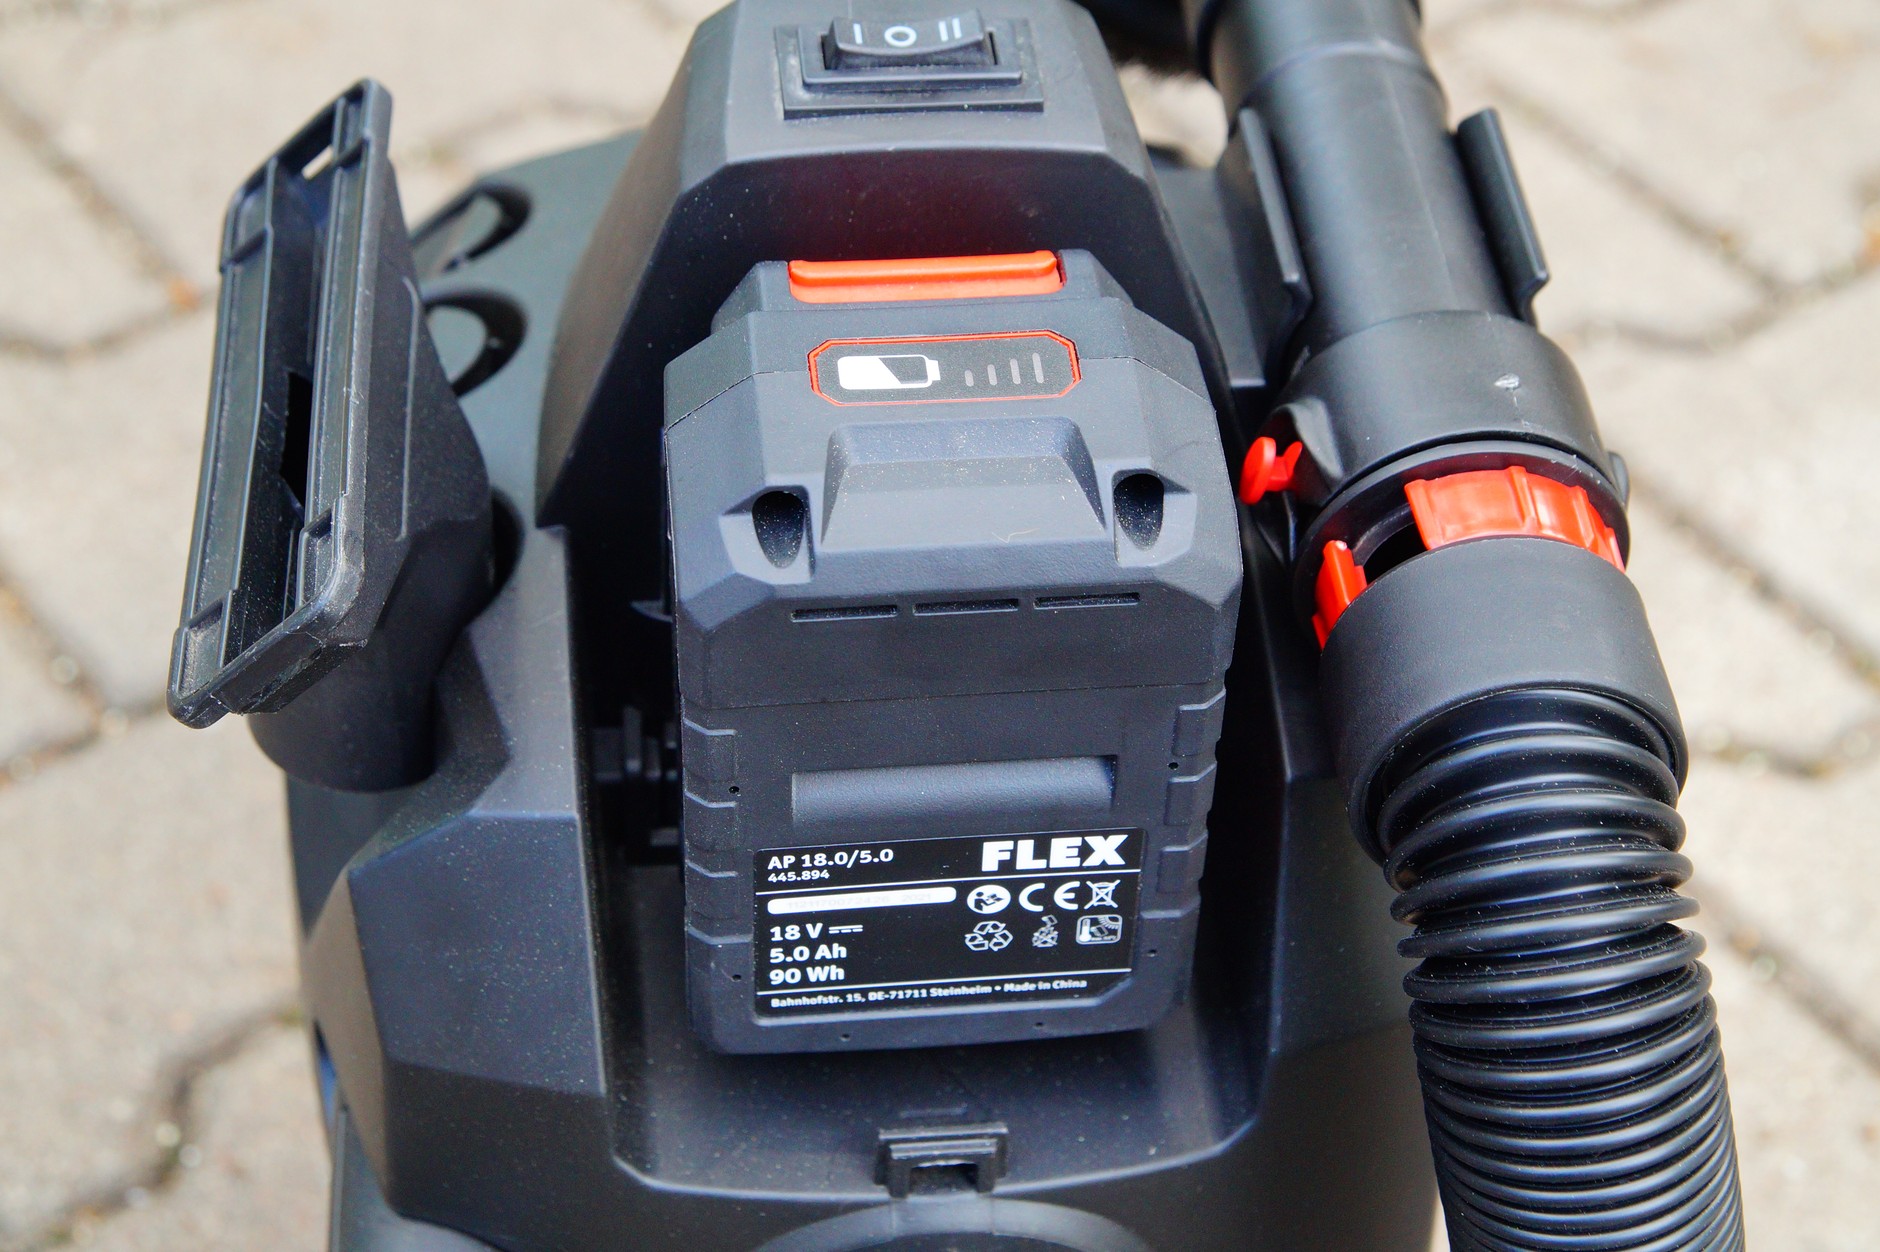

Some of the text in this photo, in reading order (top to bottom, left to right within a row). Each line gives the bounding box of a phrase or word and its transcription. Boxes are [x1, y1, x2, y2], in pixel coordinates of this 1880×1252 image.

[768, 849, 893, 869] AP 18.0/5.0
[981, 834, 1129, 872] FLEX
[768, 870, 830, 882] 445.894
[1019, 881, 1080, 912] CE
[770, 923, 823, 941] 18 V
[770, 945, 846, 963] 5.0 Ah
[770, 966, 844, 984] 90 Wh
[771, 980, 1087, 1007] Bahnhofstr. 15, DE-71711 Steinheim Made in China
